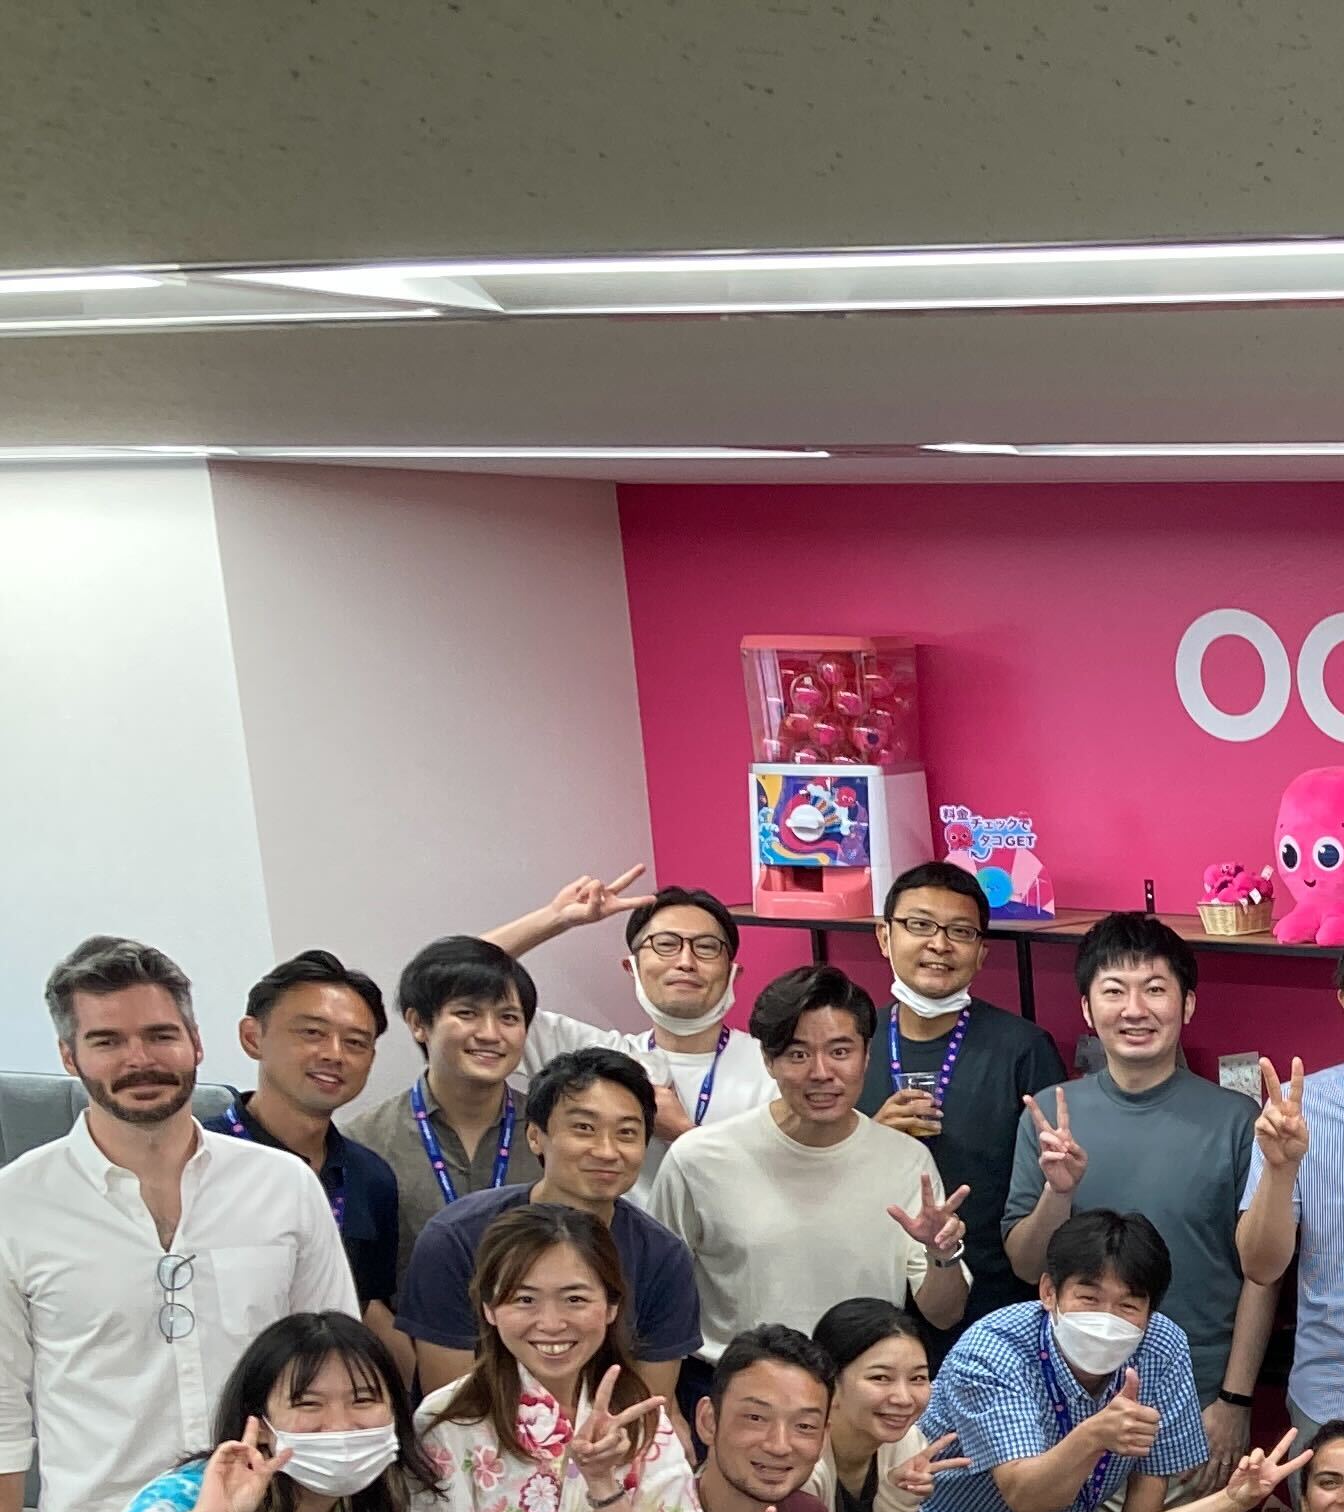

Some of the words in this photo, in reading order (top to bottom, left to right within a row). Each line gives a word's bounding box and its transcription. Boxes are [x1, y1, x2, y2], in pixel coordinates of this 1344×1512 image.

[943, 808, 969, 820] 料金
[971, 819, 1031, 831] チェックで
[980, 836, 1035, 847] タコGET
